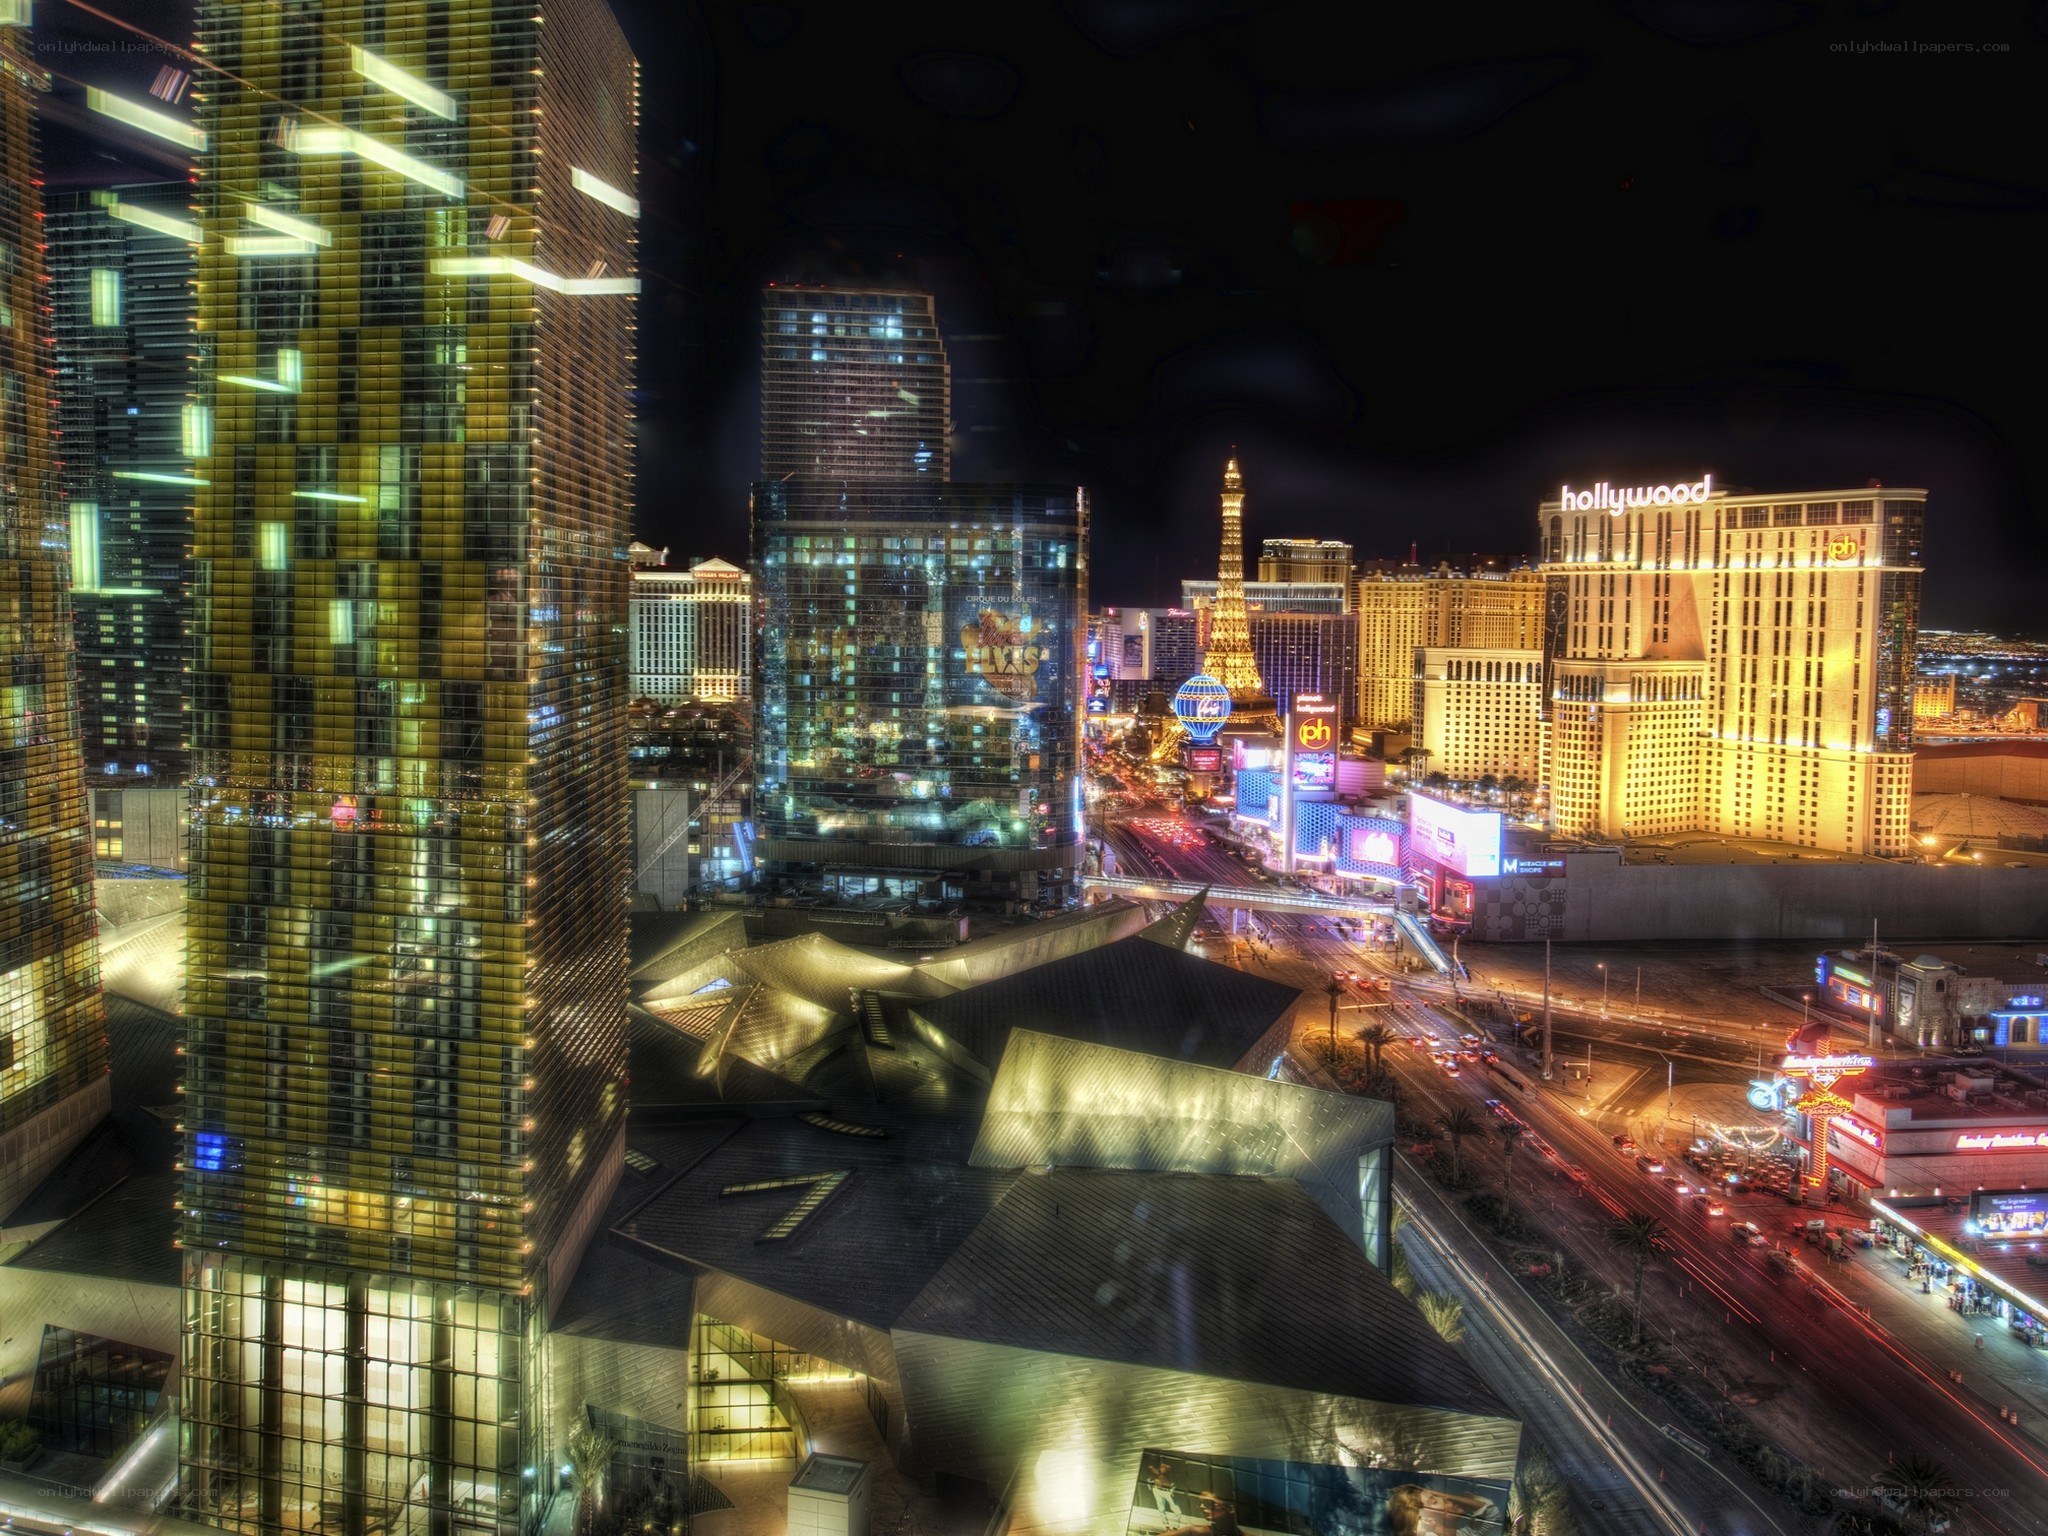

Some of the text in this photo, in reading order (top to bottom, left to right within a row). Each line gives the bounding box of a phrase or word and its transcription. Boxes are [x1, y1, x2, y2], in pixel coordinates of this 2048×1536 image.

[1560, 474, 1711, 517] hollywood
[965, 595, 996, 604] CIRQUE
[1297, 694, 1322, 703] planet
[1296, 704, 1335, 714] hollywood
[1302, 717, 1331, 746] ph
